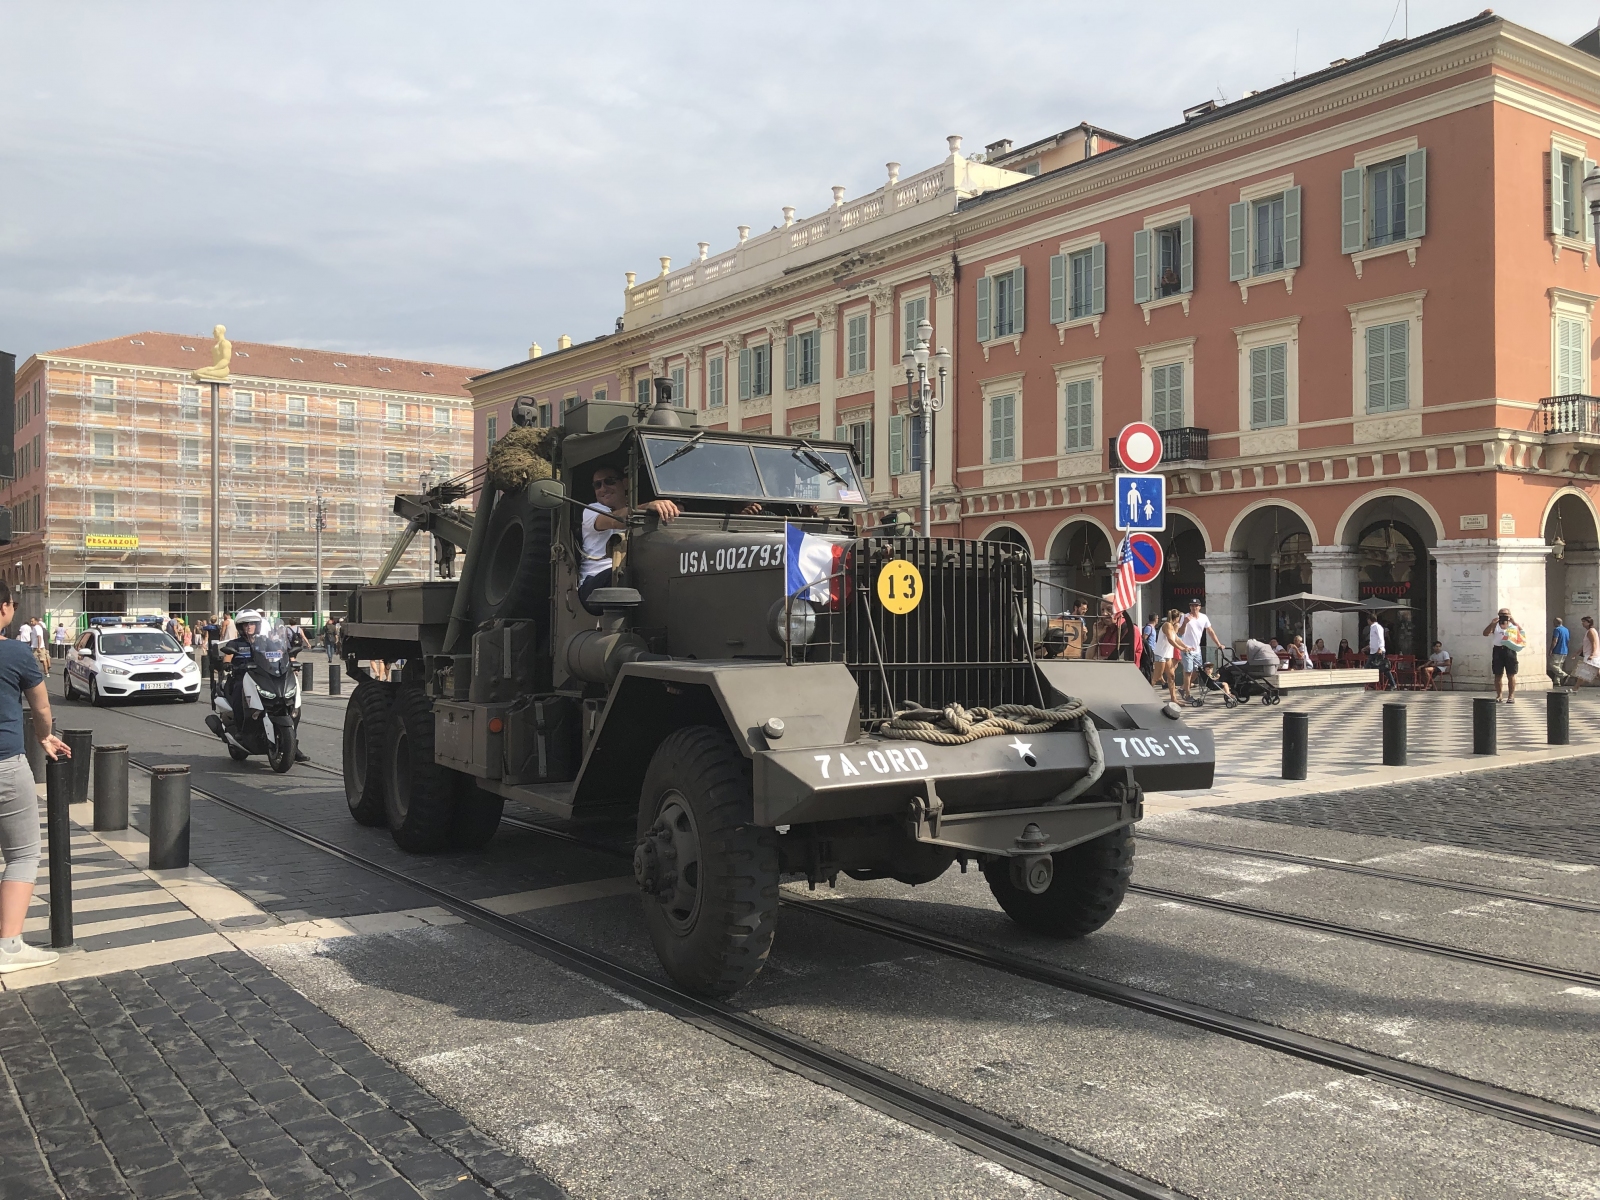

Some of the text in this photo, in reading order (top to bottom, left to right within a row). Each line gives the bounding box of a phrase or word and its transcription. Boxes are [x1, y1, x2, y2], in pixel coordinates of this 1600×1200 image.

[680, 543, 786, 574] USA-002793
[888, 574, 916, 599] 13
[1113, 735, 1201, 758] 706-15
[814, 747, 929, 779] 7A-ORD
